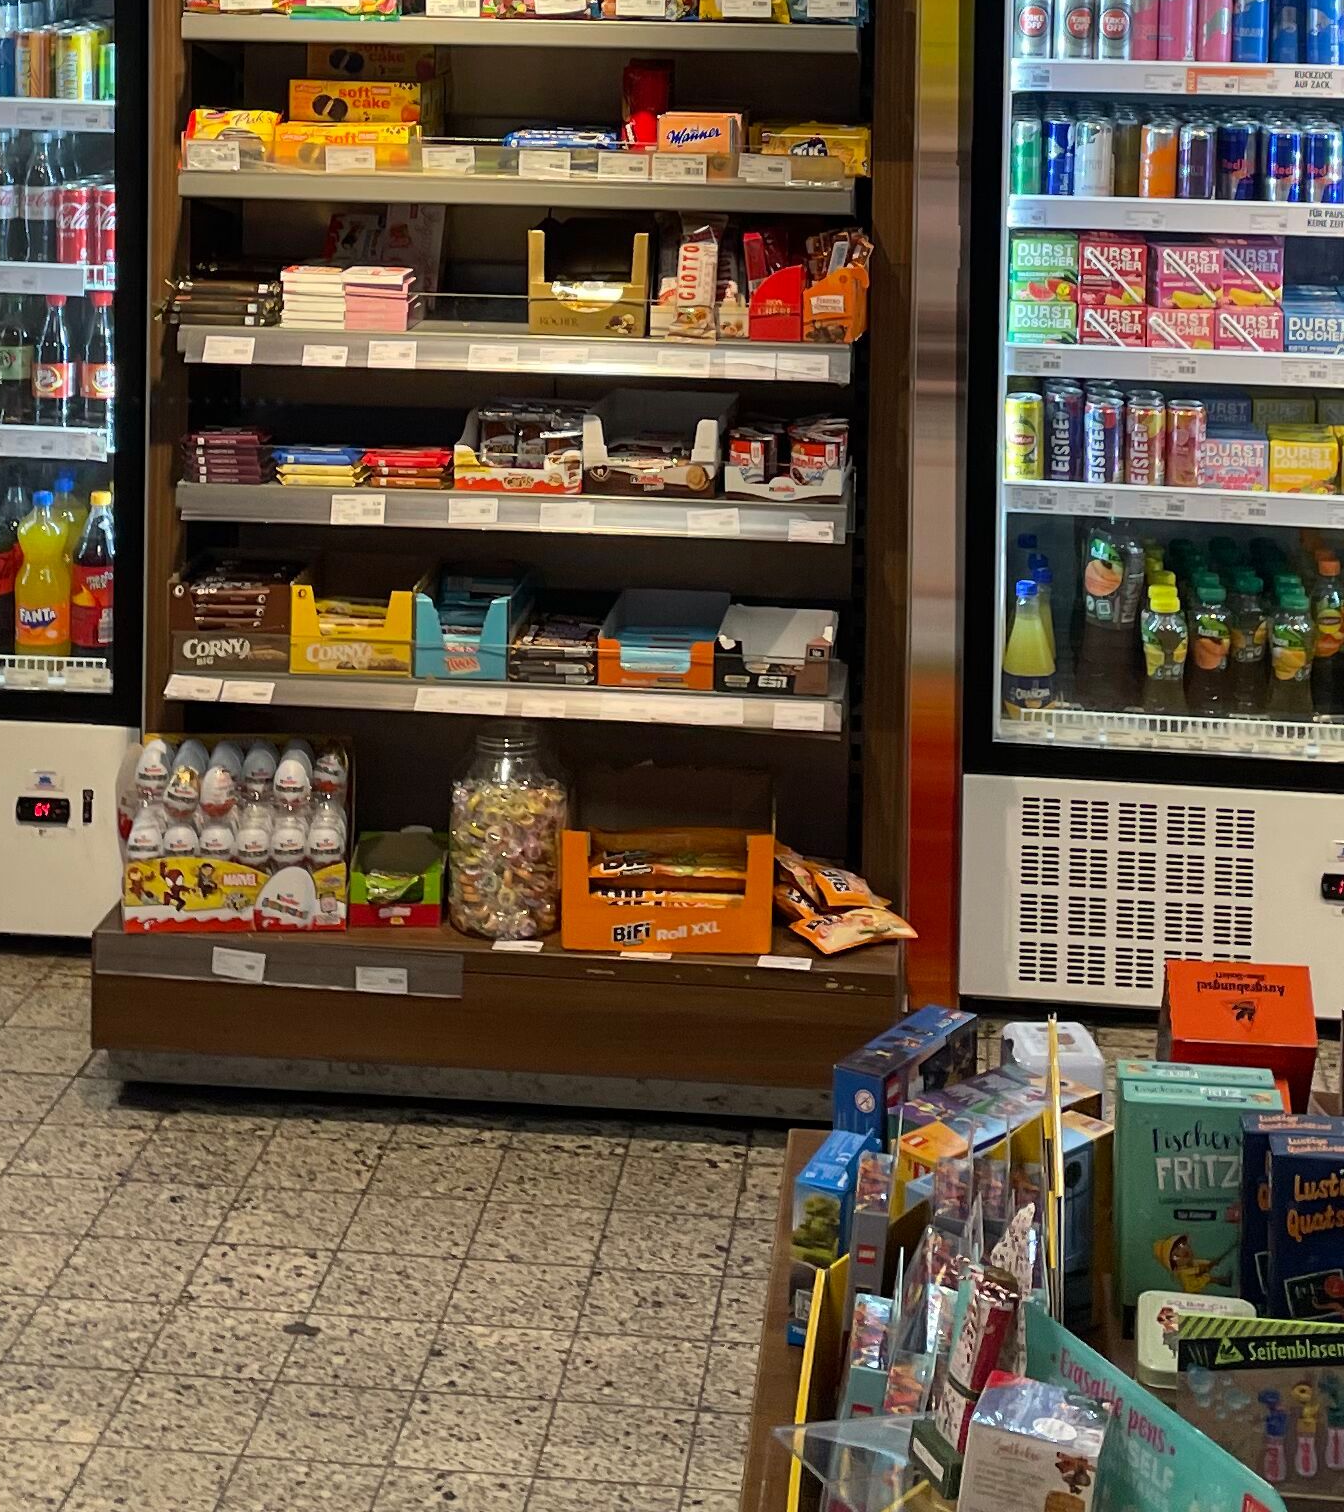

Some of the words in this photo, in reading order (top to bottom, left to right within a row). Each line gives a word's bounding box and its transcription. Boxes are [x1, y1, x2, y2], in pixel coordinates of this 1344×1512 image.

[338, 86, 372, 99] soft
[352, 98, 391, 110] cake
[666, 126, 721, 145] Manner
[1017, 243, 1075, 257] DURST
[1015, 304, 1072, 318] DURST
[1205, 443, 1265, 457] DURST
[1273, 446, 1333, 460] DURST
[182, 638, 251, 660] CORNY
[196, 656, 214, 666] BIG
[222, 873, 257, 886] MARVEL
[612, 922, 653, 943] BiFi
[655, 926, 688, 941] Roll
[691, 921, 722, 938] XXL
[1059, 1347, 1124, 1418] Erasable
[1127, 1405, 1176, 1457] pens.
